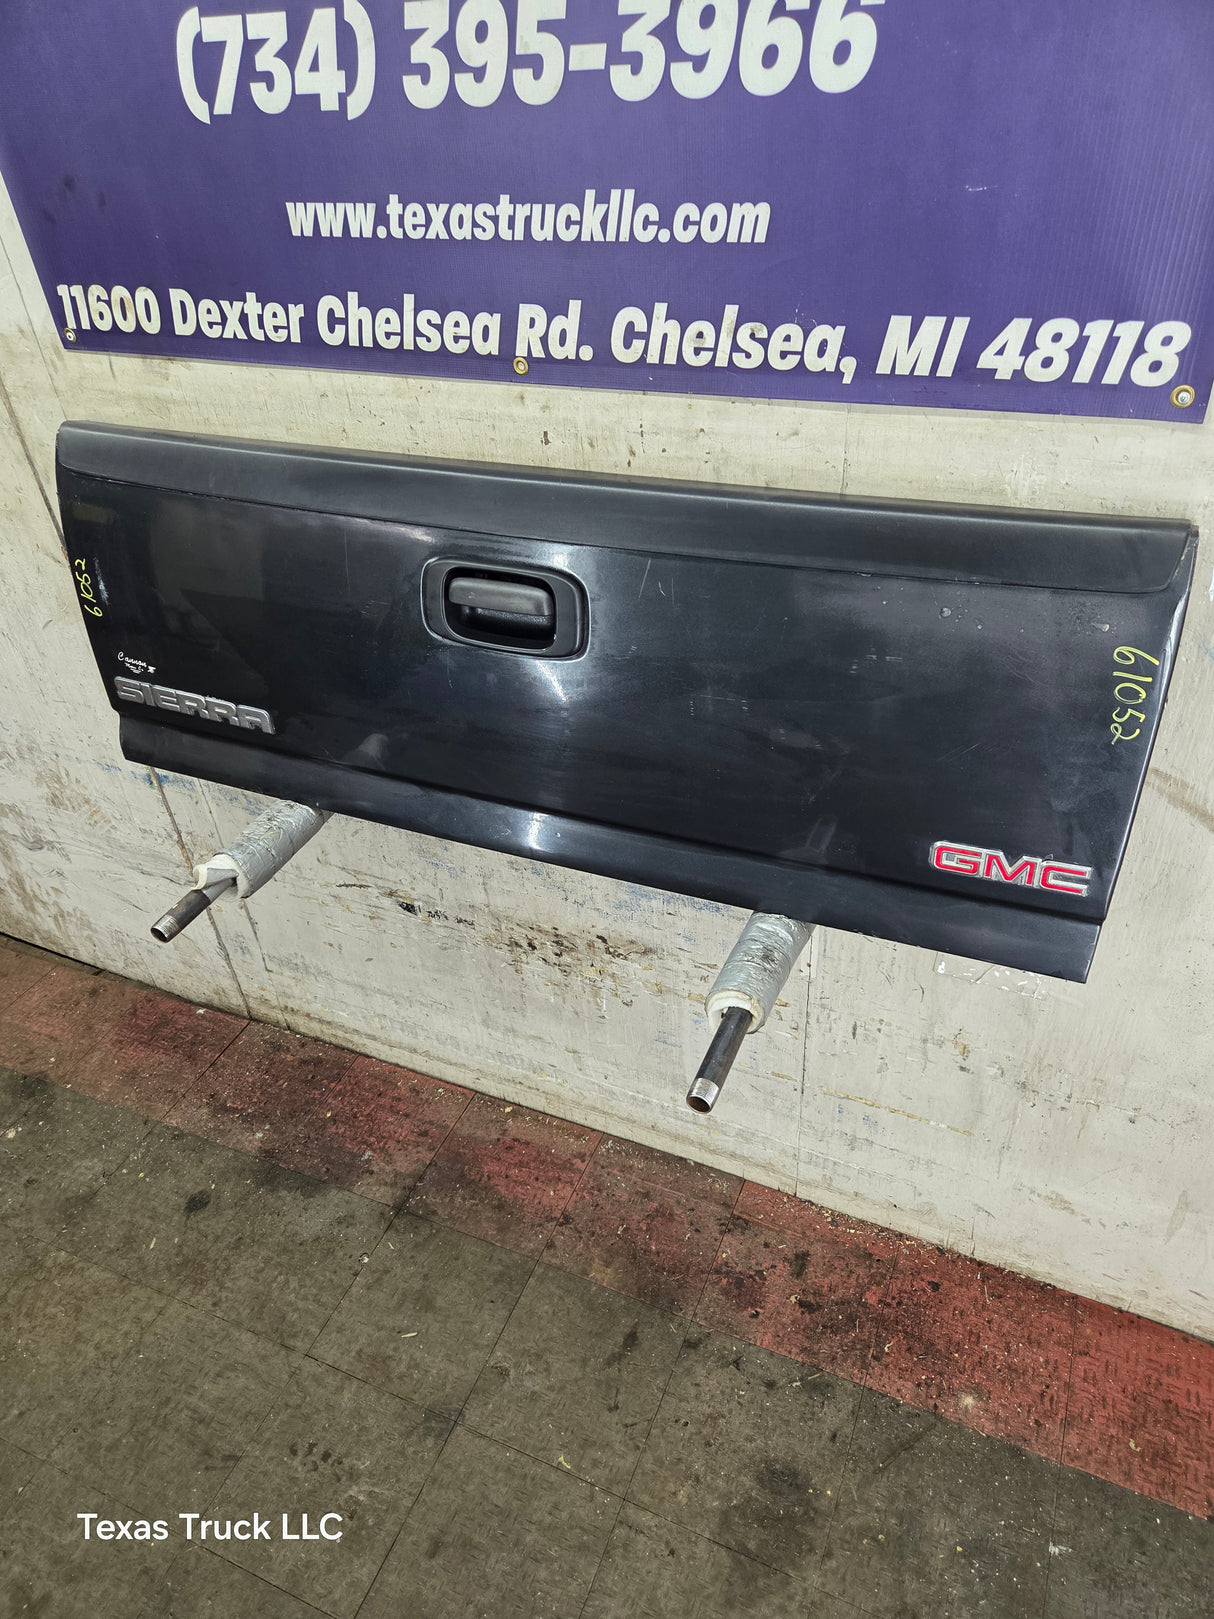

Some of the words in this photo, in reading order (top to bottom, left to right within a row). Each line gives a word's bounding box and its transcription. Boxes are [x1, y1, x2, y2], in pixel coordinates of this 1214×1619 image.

[176, 0, 376, 124] (734)
[403, 0, 885, 109] 395-3966
[285, 189, 771, 244] www.texastruckllc.com
[57, 284, 161, 334] 11600
[168, 288, 305, 343] Dexter
[317, 291, 501, 356] Chelsea
[514, 300, 594, 361] Rd.
[610, 302, 857, 384] Chelsea,
[875, 315, 971, 377] MI
[976, 317, 1192, 387] 48118
[75, 558, 103, 617] 61052
[114, 675, 276, 735] SIERRA
[1110, 646, 1160, 745] 61052
[929, 840, 1094, 897] GMC
